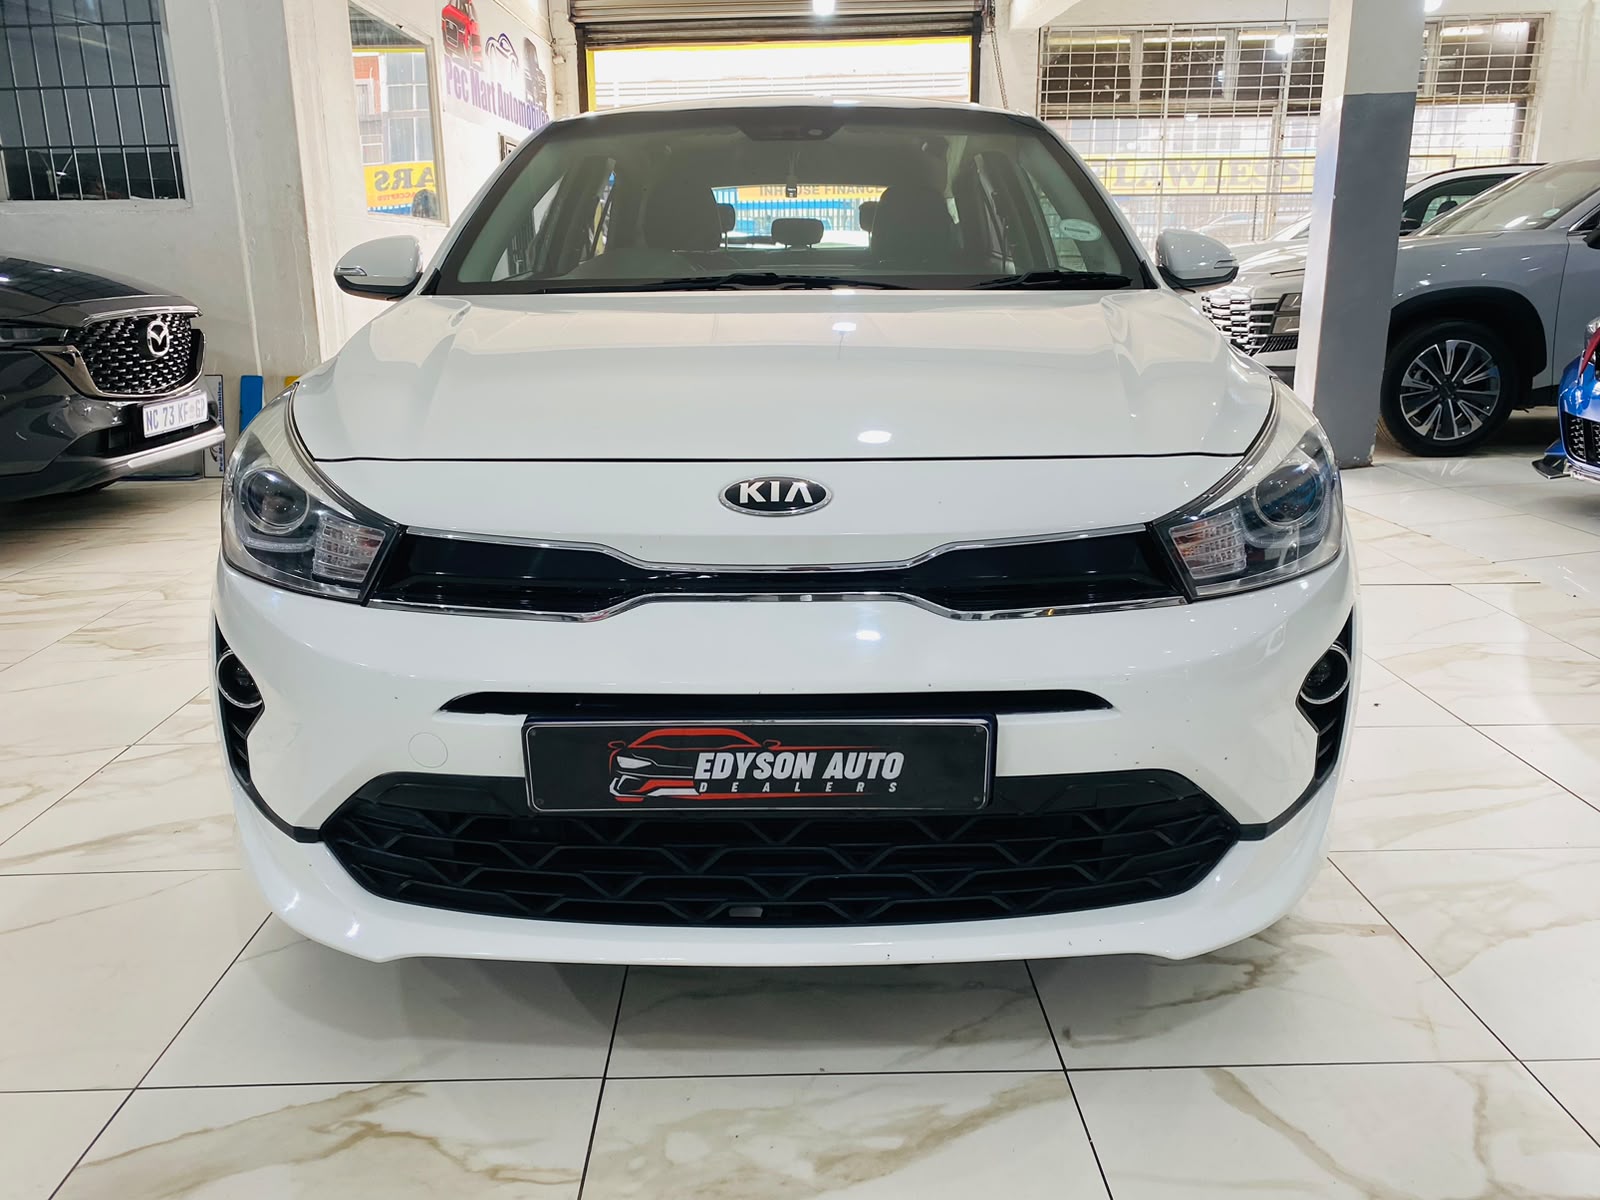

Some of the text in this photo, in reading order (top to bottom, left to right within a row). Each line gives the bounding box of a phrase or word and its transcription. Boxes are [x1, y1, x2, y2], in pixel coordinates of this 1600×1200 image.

[444, 54, 470, 103] Pec
[470, 68, 498, 116] Mart
[759, 185, 821, 196] INHUSE
[824, 185, 883, 195] FINANCE
[146, 398, 205, 431] NC 73 KF GP
[739, 480, 813, 504] KIA
[694, 752, 905, 780] EDYSON AUTO
[699, 782, 897, 793] DEALERS
